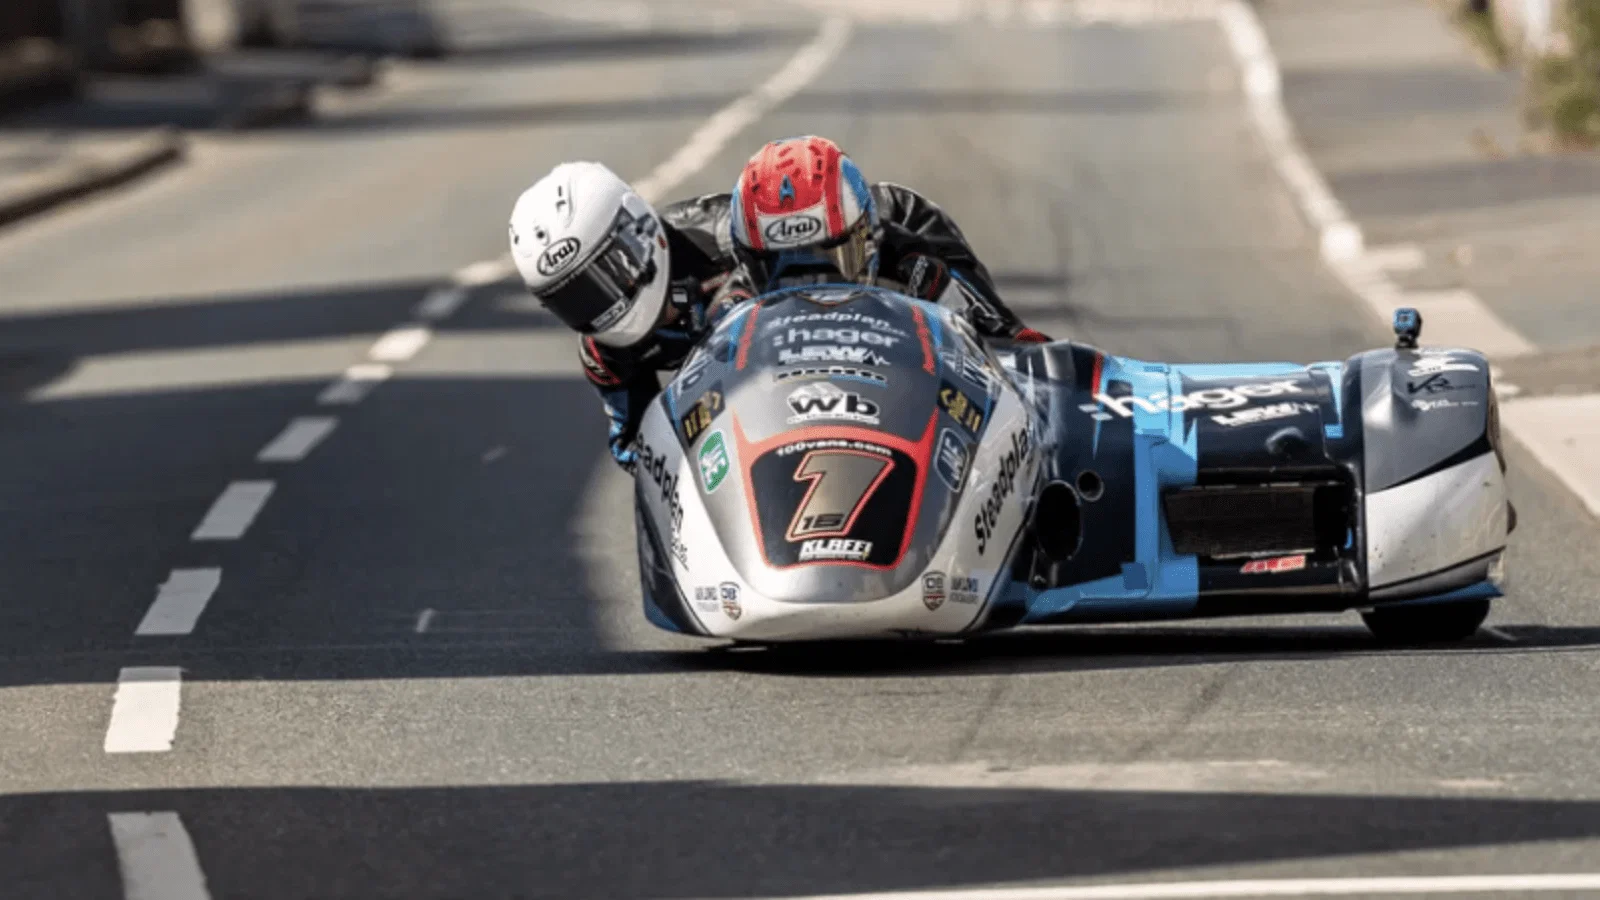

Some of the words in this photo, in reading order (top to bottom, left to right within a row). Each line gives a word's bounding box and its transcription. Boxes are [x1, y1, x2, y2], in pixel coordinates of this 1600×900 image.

[772, 217, 814, 238] Arai
[543, 240, 576, 270] Arai
[787, 328, 900, 348] hager
[791, 395, 878, 415] wb
[1092, 379, 1303, 417] hager
[776, 440, 893, 456] 100vans.com
[785, 449, 896, 542] 1
[975, 413, 1030, 556] Steadpla
